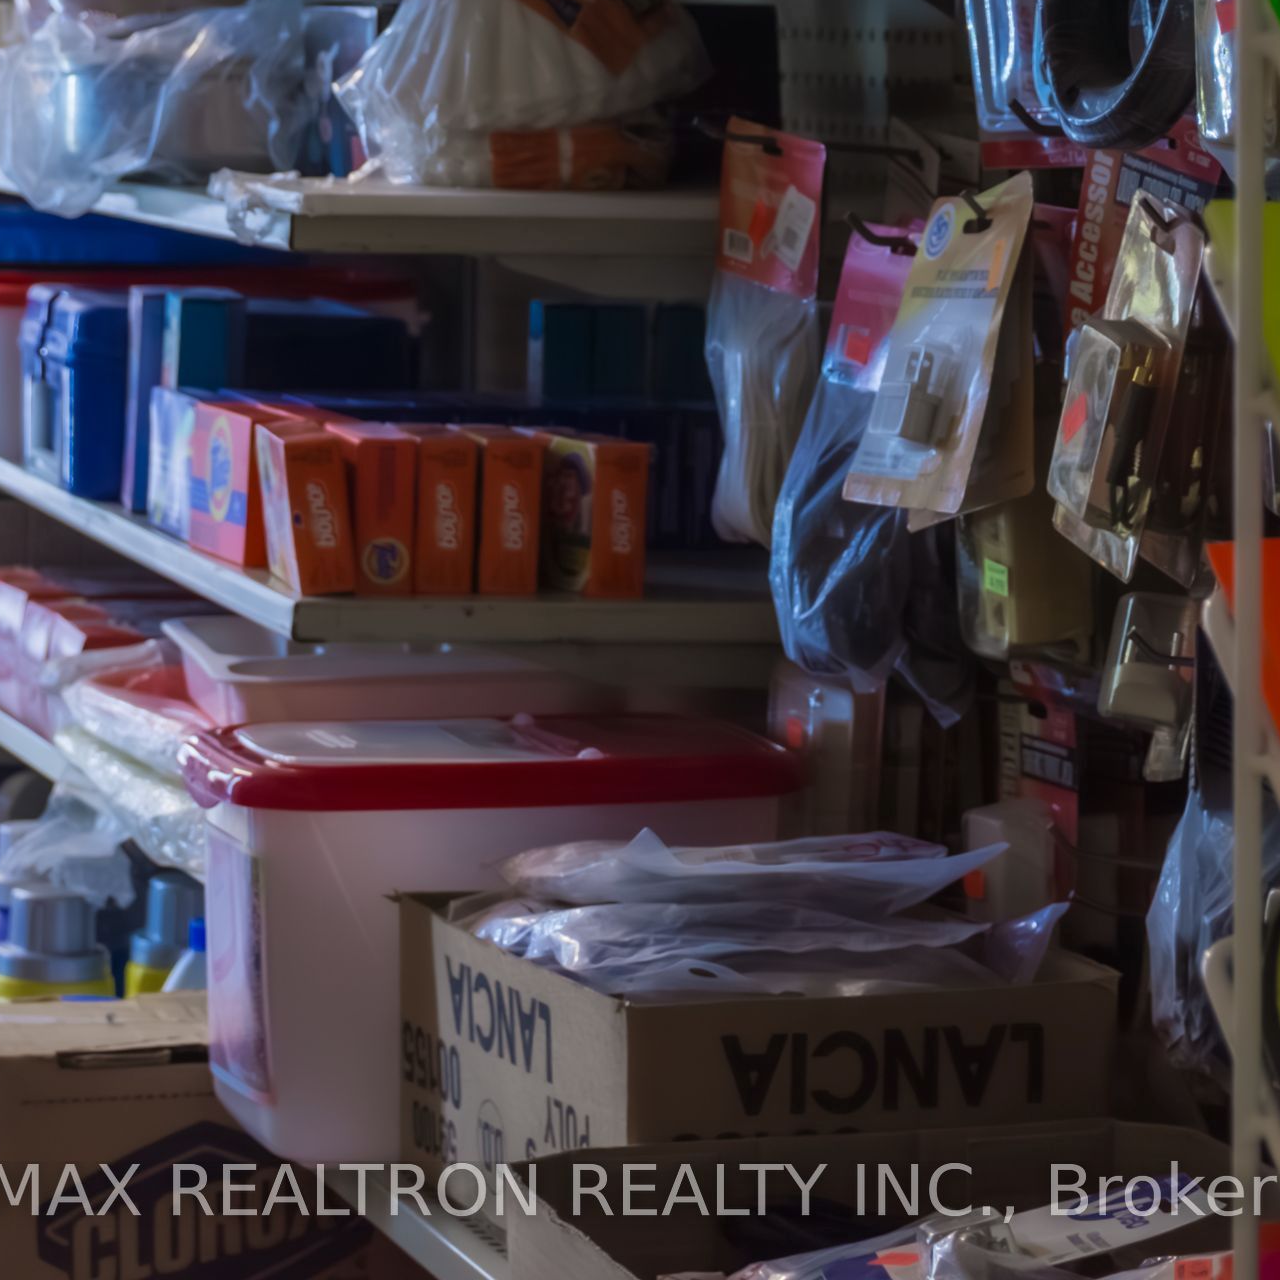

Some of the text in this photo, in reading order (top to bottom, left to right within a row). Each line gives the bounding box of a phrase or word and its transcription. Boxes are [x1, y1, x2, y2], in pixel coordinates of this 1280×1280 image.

[402, 1021, 462, 1111] 00155
[445, 955, 554, 1084] LANCIA
[721, 1021, 1046, 1118] LANCIA
